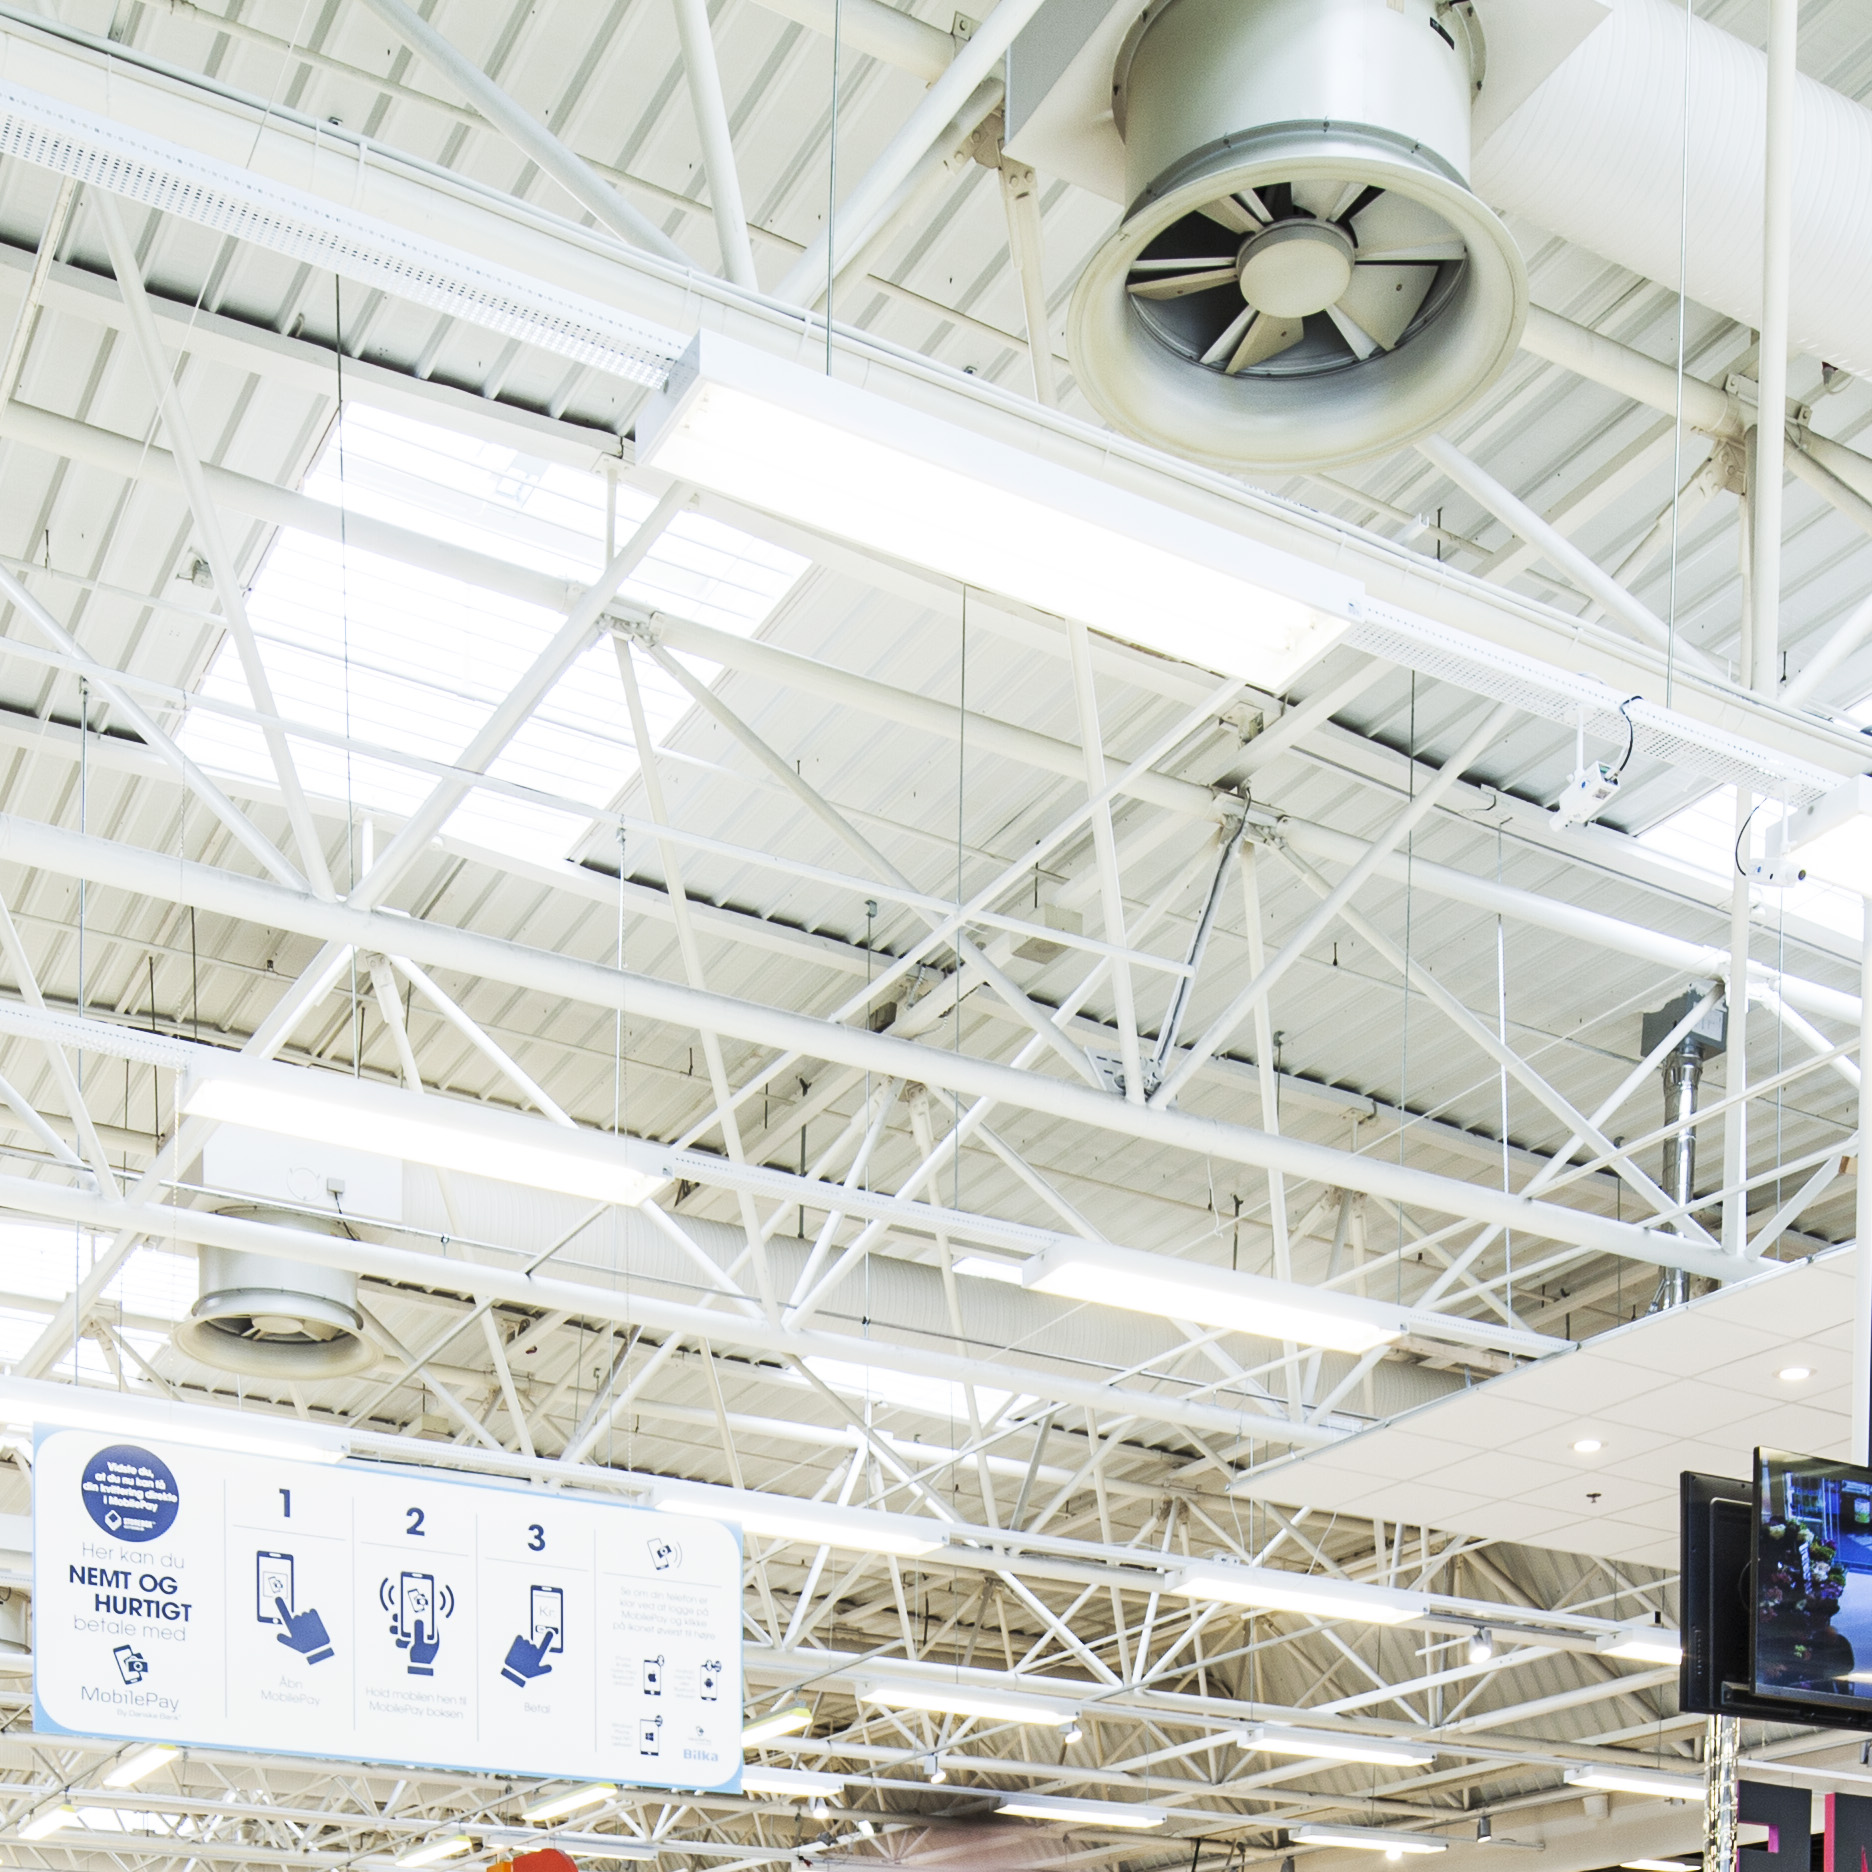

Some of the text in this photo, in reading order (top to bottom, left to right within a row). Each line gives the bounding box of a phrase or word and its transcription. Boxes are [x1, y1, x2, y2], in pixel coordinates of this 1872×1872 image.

[108, 1495, 158, 1513] MobilePay
[278, 1488, 292, 1519] 1
[406, 1507, 426, 1537] 2
[527, 1525, 546, 1553] 3
[82, 1541, 185, 1569] Her kan du
[69, 1564, 178, 1595] NEMT OG
[94, 1593, 192, 1622] HURTIGT
[74, 1615, 186, 1642] betale med
[279, 1675, 303, 1689] Åbn
[365, 1686, 390, 1699] Hold
[392, 1689, 435, 1703] mobilen
[436, 1693, 457, 1705] hen
[81, 1686, 179, 1713] MobilePay
[261, 1689, 321, 1707] MobilePay
[369, 1701, 464, 1719] MobilePay boksen
[524, 1702, 550, 1714] Betal
[683, 1748, 719, 1762] Bilka
